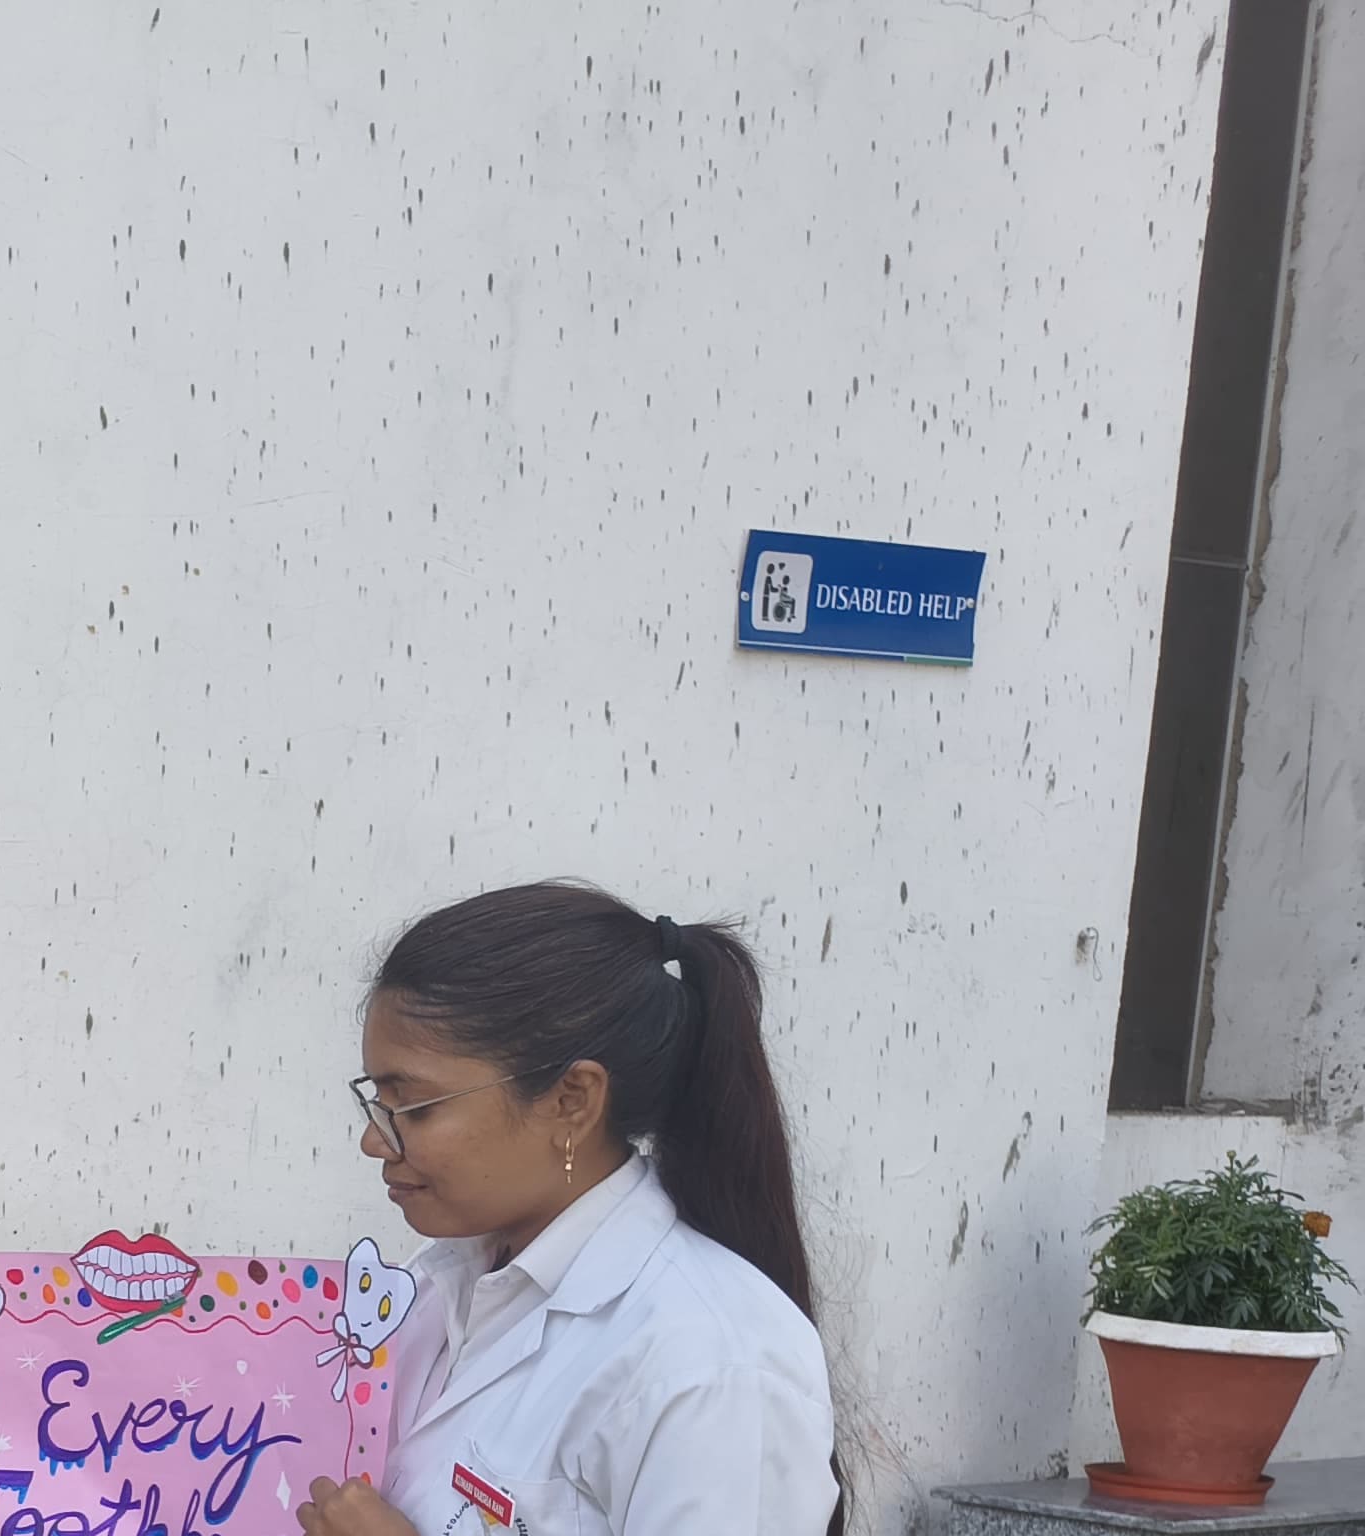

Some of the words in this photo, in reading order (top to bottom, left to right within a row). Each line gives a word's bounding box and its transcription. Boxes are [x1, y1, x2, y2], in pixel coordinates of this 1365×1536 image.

[816, 583, 912, 616] DISABLED
[919, 593, 967, 620] HELP
[37, 1359, 301, 1525] Every
